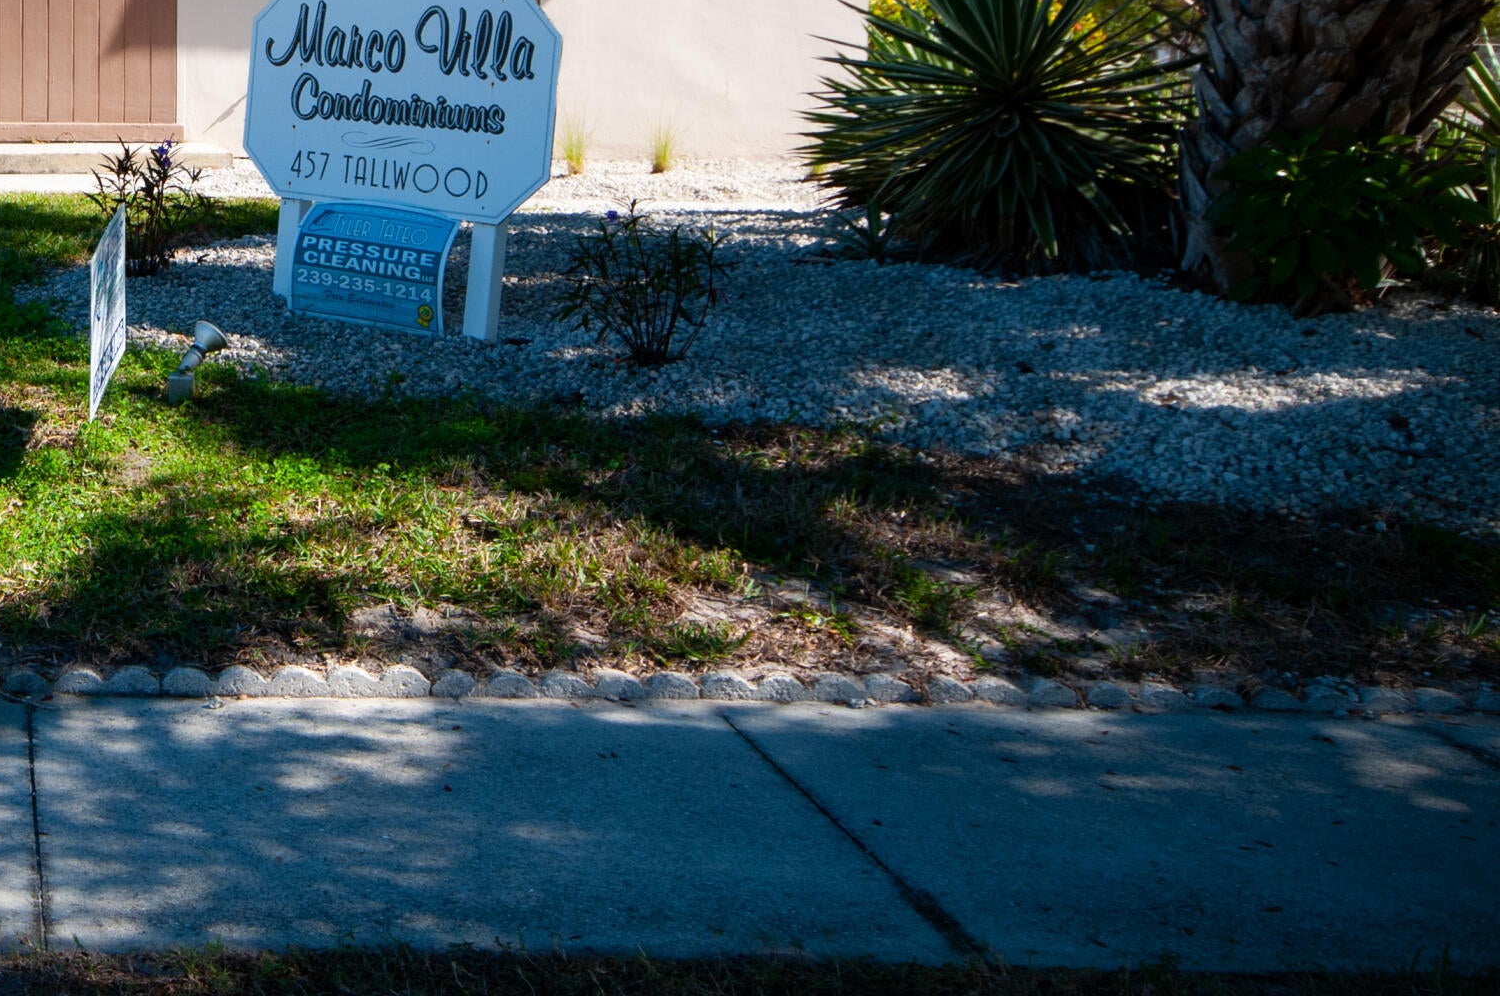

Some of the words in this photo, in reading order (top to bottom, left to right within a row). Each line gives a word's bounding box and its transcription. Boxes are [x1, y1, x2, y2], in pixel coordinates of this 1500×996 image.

[265, 0, 406, 73] Marco
[415, 5, 535, 81] Villa
[291, 72, 505, 134] Condominiums
[291, 150, 329, 181] 457
[343, 155, 488, 199] TALLWOOD
[332, 214, 372, 238] TYLER
[302, 235, 436, 267] PRESSURE
[303, 250, 421, 280] CLEANING
[297, 268, 432, 303] 239-235-1214
